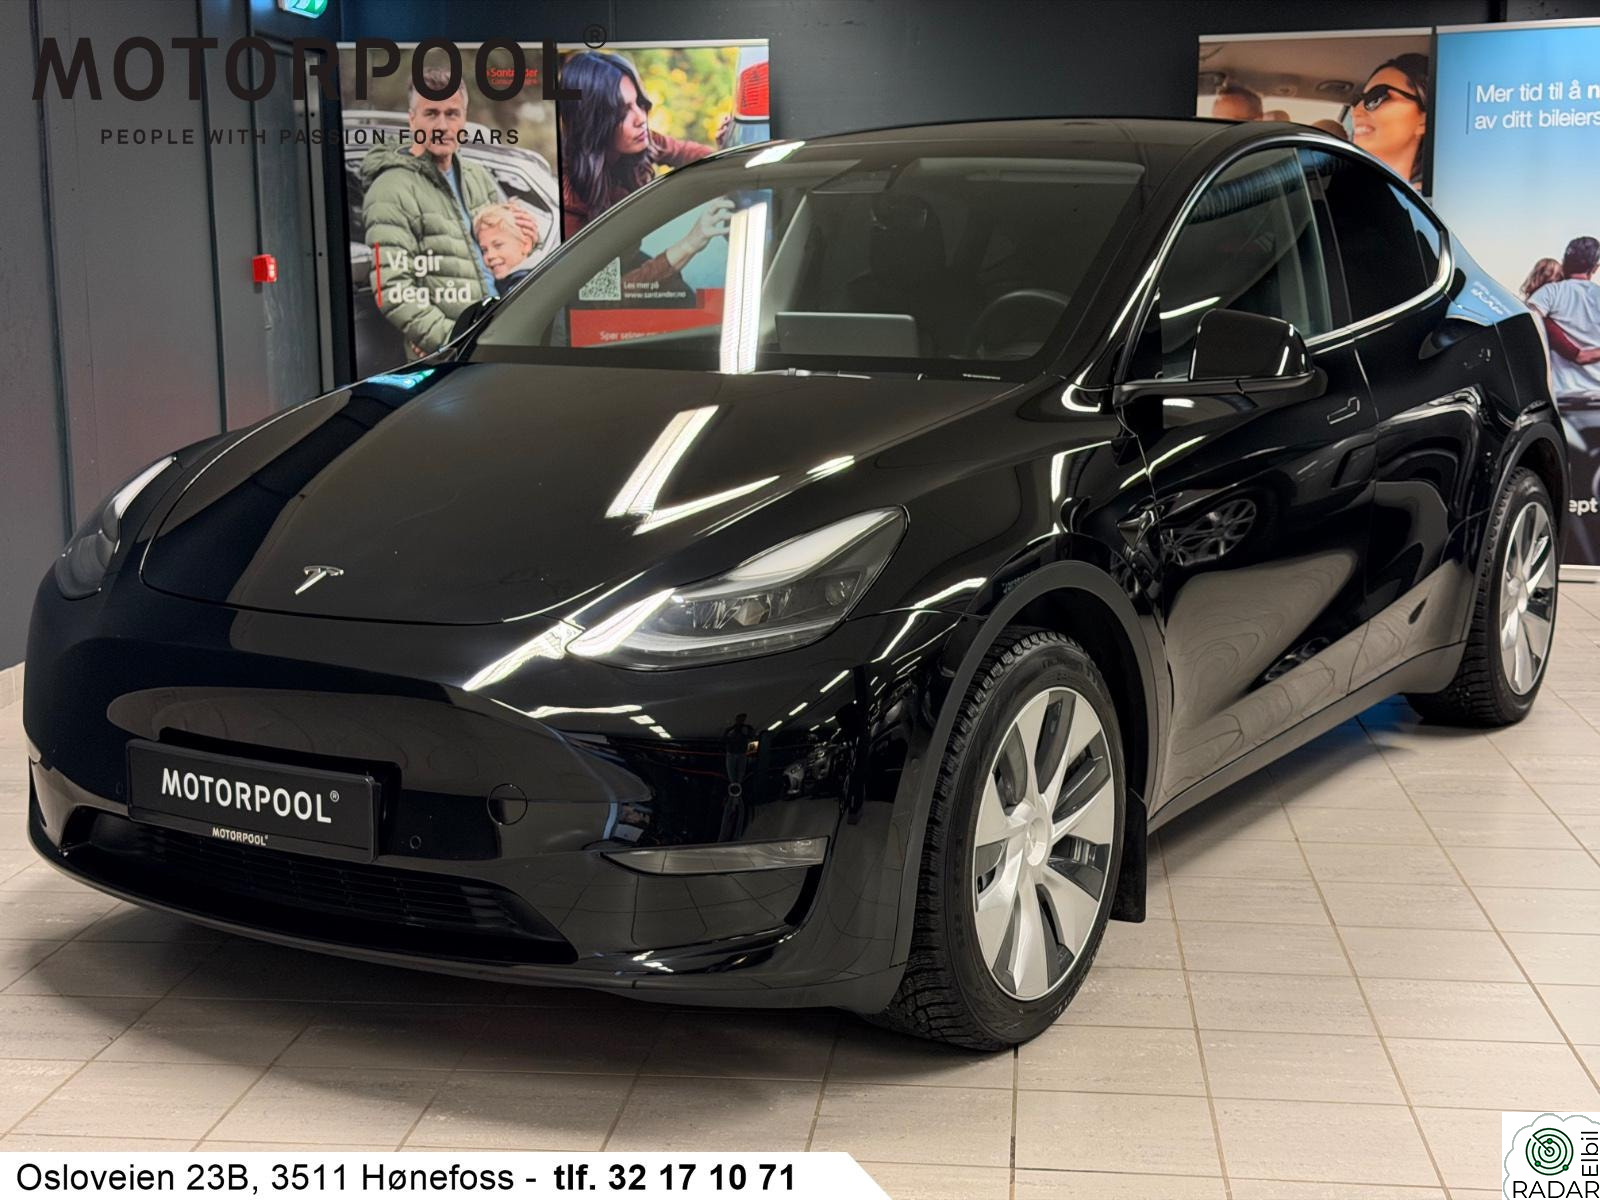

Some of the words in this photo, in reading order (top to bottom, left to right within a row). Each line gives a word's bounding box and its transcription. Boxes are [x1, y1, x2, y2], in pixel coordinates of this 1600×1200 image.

[1476, 85, 1514, 103] Mer
[1519, 83, 1543, 101] tid
[1548, 81, 1563, 100] til
[1568, 79, 1582, 100] å
[1474, 115, 1498, 129] av
[1502, 110, 1533, 128] ditt
[386, 249, 409, 272] Vi
[414, 249, 443, 277] gir
[388, 281, 430, 309] deg
[435, 280, 472, 304] råd
